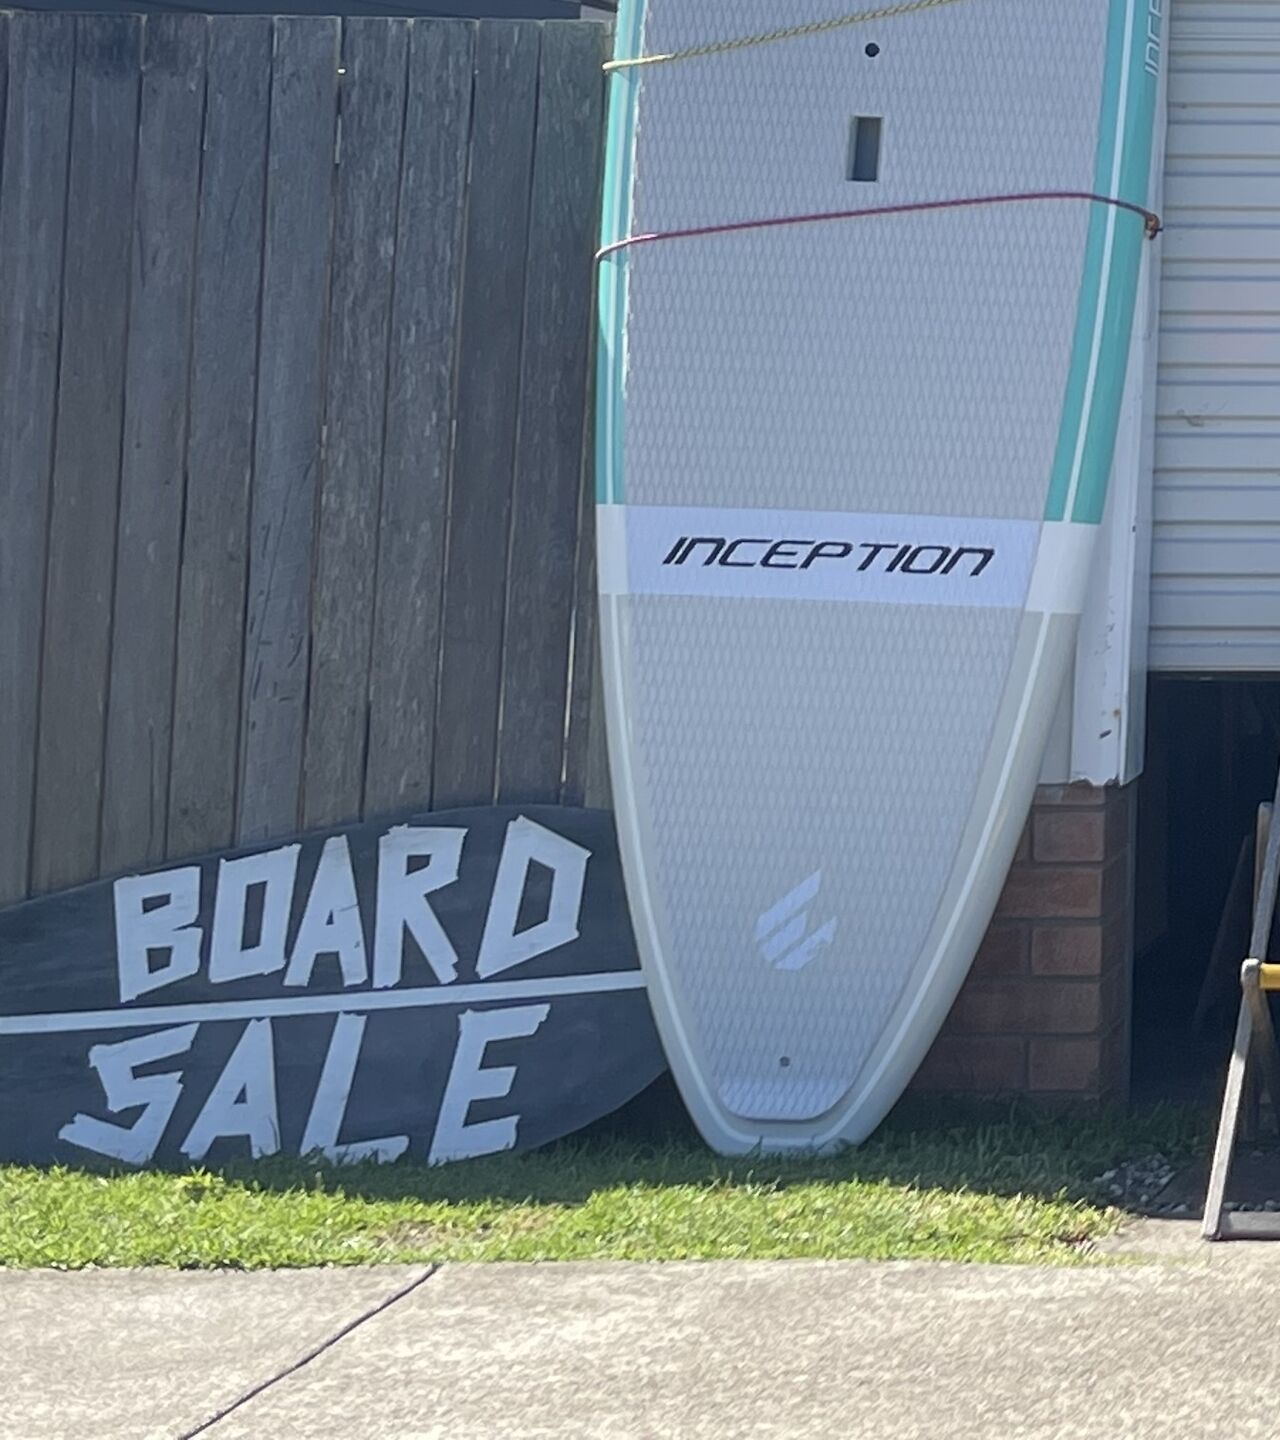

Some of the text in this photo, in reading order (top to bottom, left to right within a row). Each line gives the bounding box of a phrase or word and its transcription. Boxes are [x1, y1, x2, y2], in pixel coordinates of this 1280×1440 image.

[662, 537, 995, 576] INCEPTION
[114, 814, 592, 1003] BOARD
[57, 1003, 551, 1166] SALE
